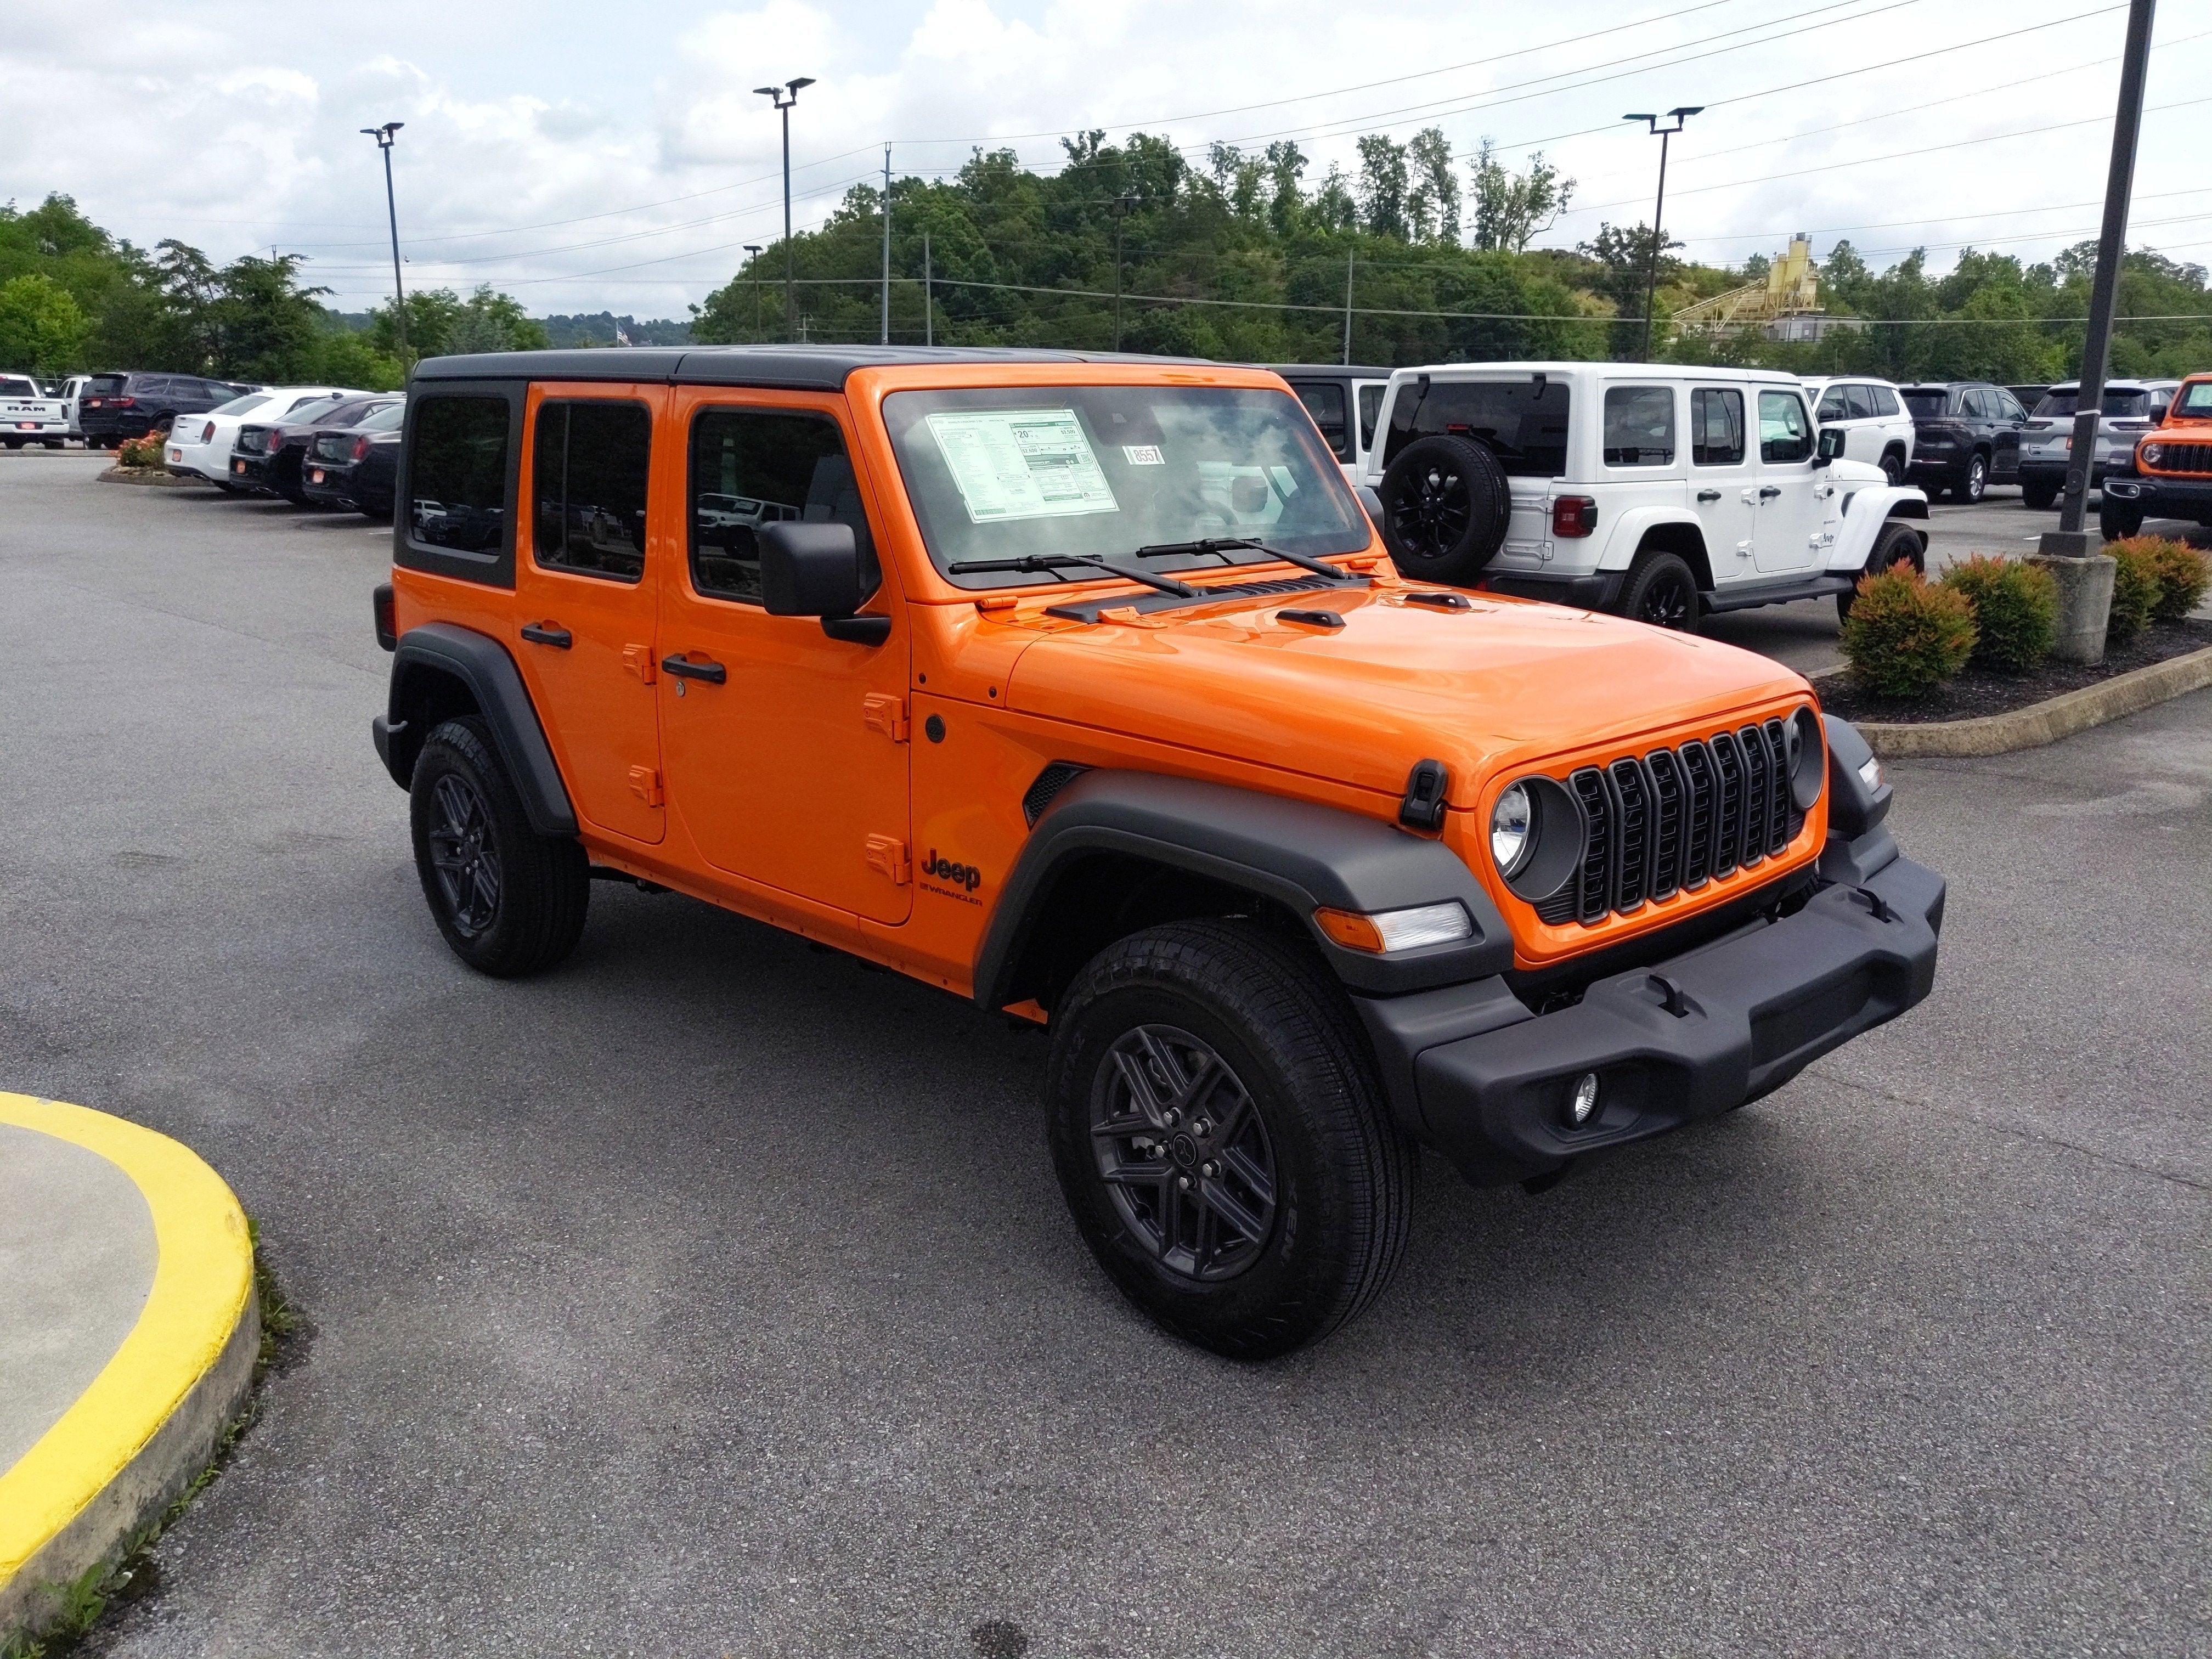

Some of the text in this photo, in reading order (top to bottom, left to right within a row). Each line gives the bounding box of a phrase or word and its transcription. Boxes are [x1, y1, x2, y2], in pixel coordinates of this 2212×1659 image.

[1133, 449, 1159, 462] 8557
[921, 847, 981, 893] Jeep
[929, 884, 983, 906] WRANGLER
